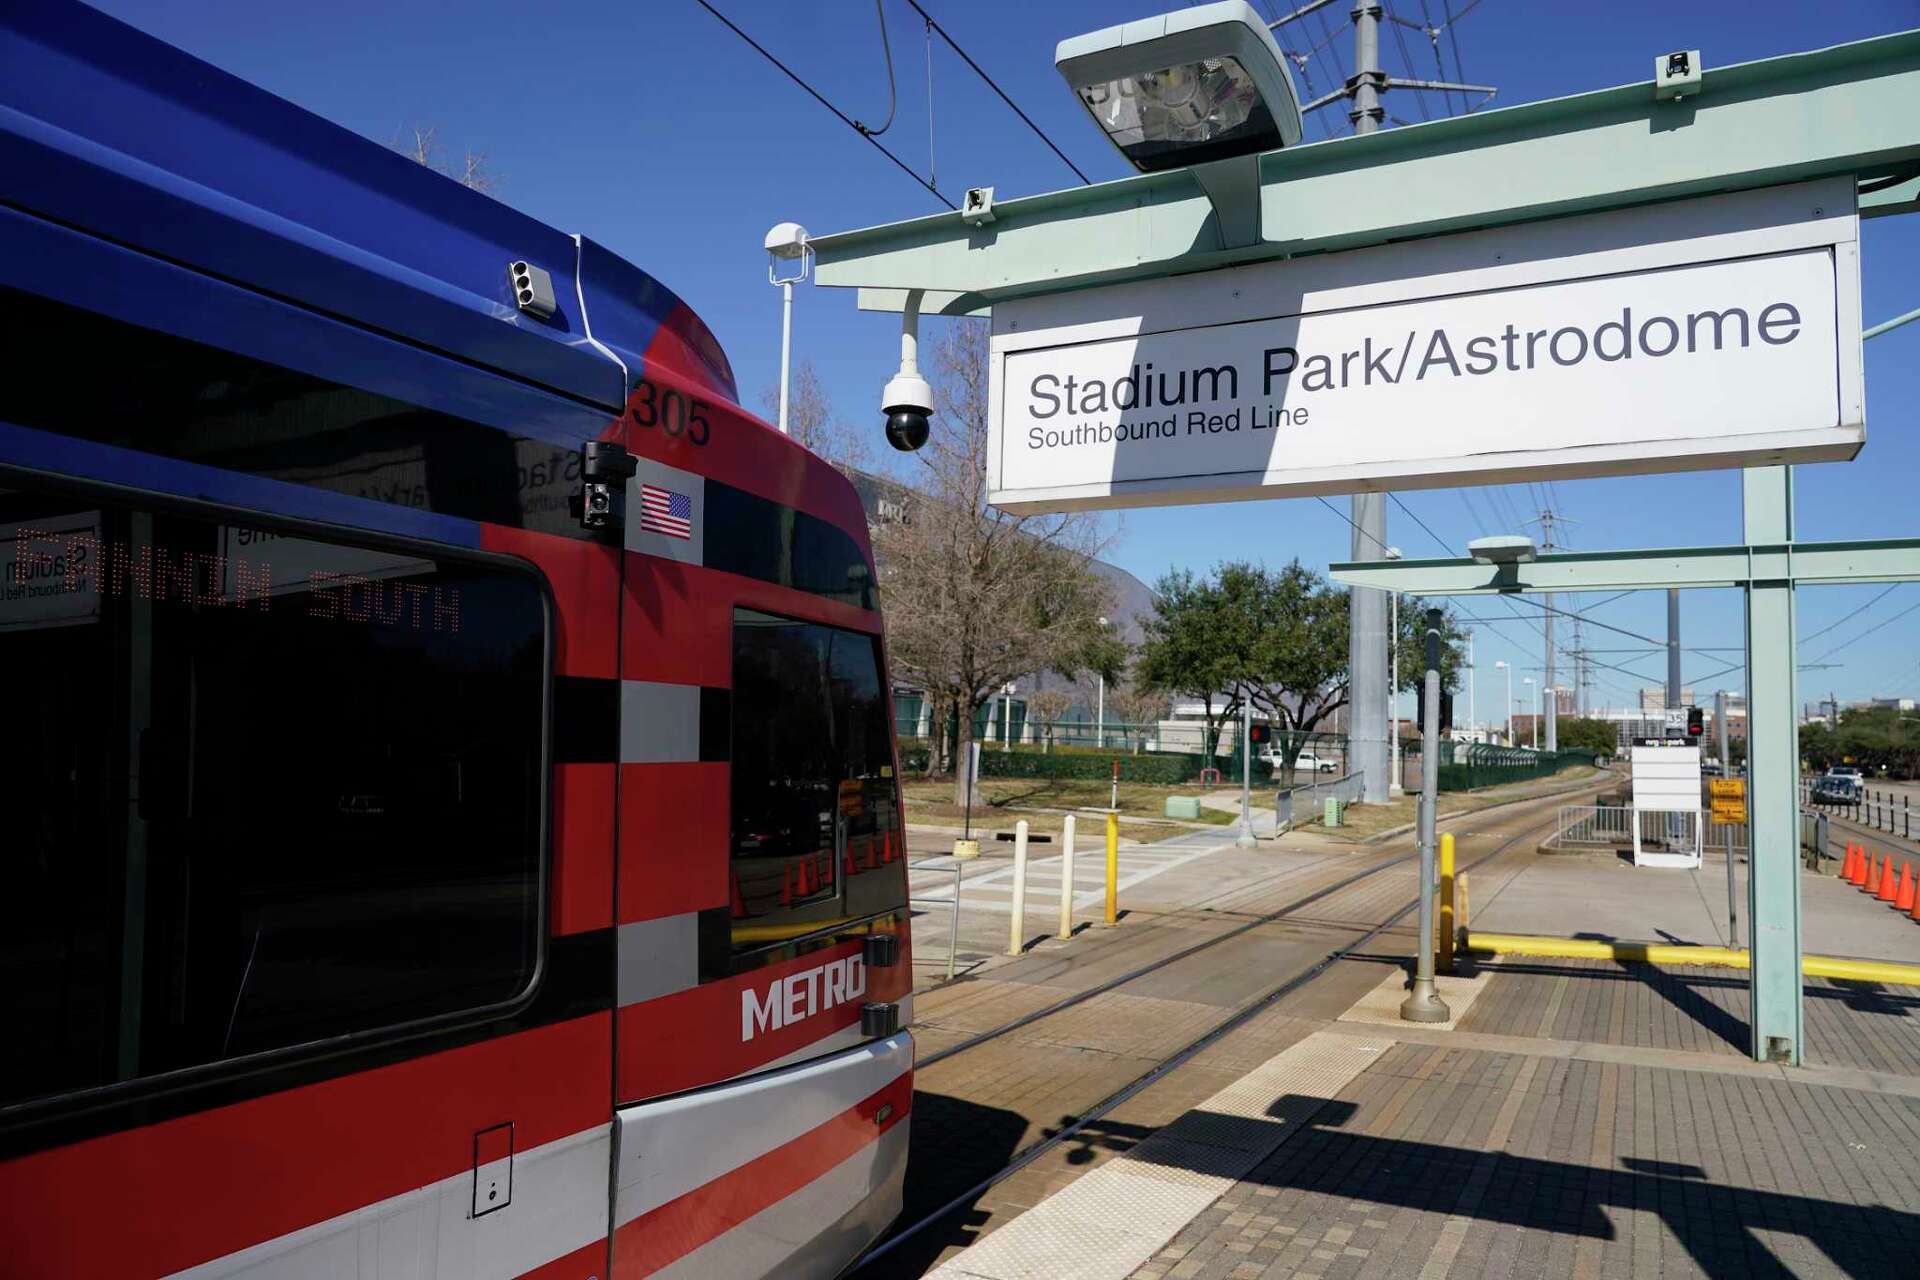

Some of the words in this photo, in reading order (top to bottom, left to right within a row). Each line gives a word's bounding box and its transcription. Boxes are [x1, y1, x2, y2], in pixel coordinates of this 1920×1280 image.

[1028, 362, 1238, 419] Stadium
[1263, 302, 1801, 396] Park/Astrodome
[632, 379, 711, 446] 305
[1028, 414, 1177, 449] Southbound
[1187, 409, 1241, 434] Red
[1251, 403, 1309, 429] Line
[15, 527, 272, 611] FANNIN
[309, 568, 460, 632] SOUTH
[742, 953, 866, 1042] METRO
